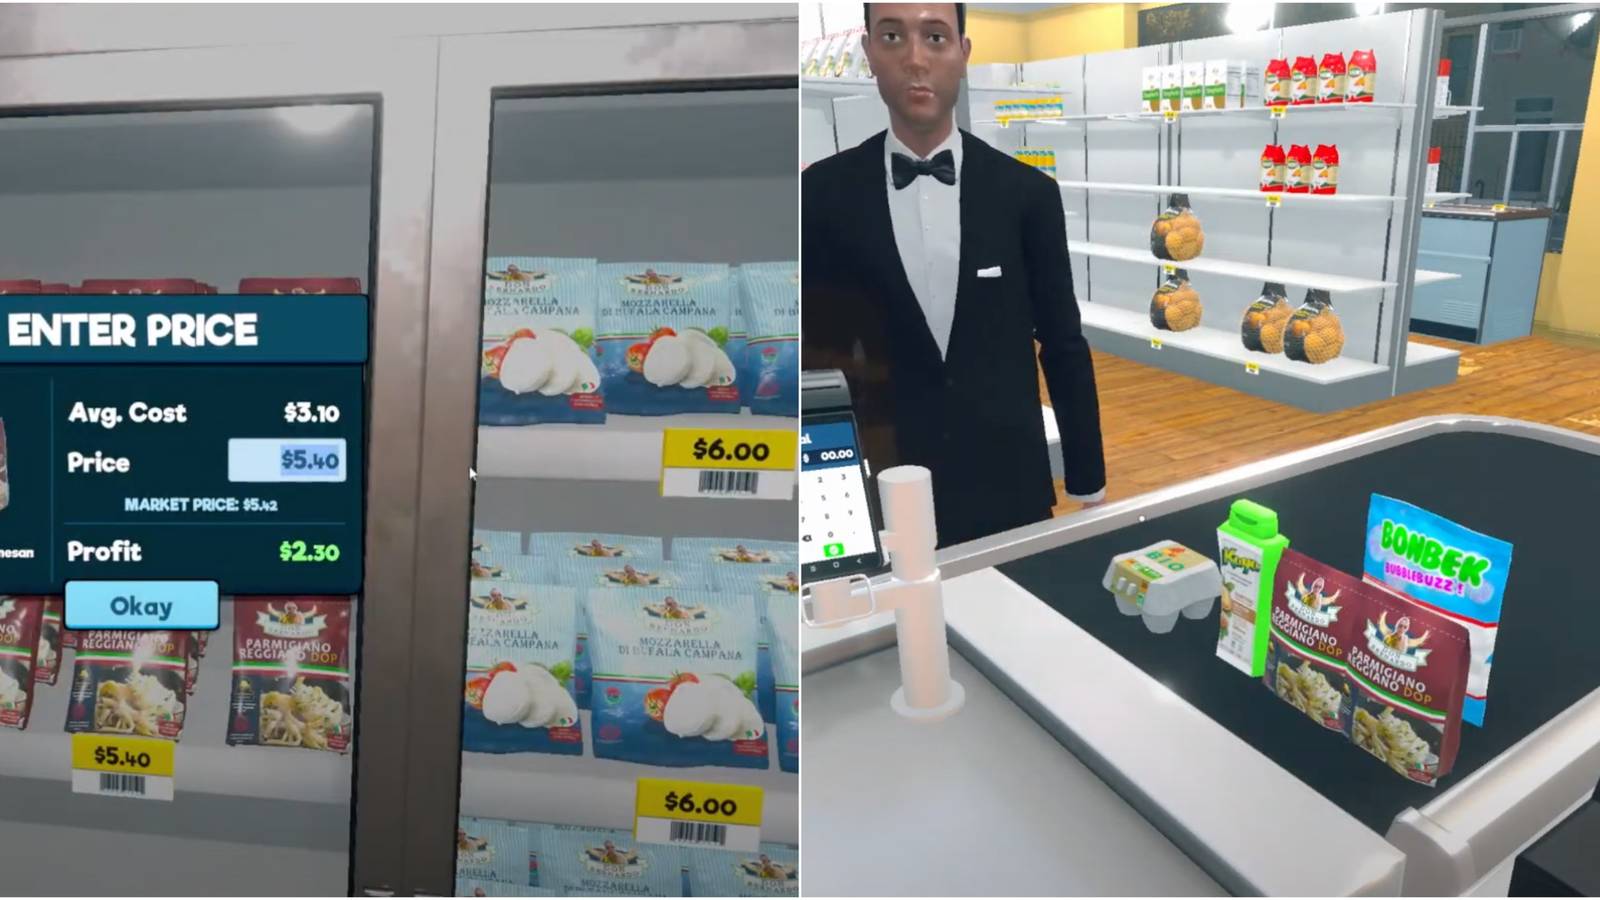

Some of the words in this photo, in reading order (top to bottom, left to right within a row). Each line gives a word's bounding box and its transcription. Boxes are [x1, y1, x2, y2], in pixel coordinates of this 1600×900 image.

[486, 296, 559, 307] OZZARELLA
[522, 305, 580, 317] CAMPANA
[621, 298, 697, 308] MOZZARELLA
[662, 306, 717, 318] CAMPANA
[8, 312, 137, 347] ENTER
[146, 312, 258, 347] PRICE
[67, 401, 123, 428] Avg.
[128, 401, 187, 423] Cost
[284, 401, 340, 423] $3.10
[280, 448, 339, 470] $5.40
[693, 437, 770, 462] $6.00
[820, 448, 854, 461] 00.00
[67, 451, 131, 473] Price
[124, 497, 190, 512] MARKET
[192, 497, 239, 512] PRICE:
[242, 497, 279, 512] $5.42
[67, 540, 142, 562] Profit
[279, 540, 340, 562] $2.30
[1380, 520, 1490, 588] BONBEK
[110, 595, 173, 621] Okay
[1275, 606, 1337, 647] PARMIGIANO
[82, 639, 142, 651] REGGIAN
[88, 630, 169, 644] PARMIGI
[245, 638, 332, 653] PARMIGIANO
[503, 638, 560, 650] CAMPANA
[639, 637, 721, 650] MOZZARELLA
[239, 648, 306, 661] REGGIAO
[310, 651, 338, 663] DOP
[617, 645, 630, 656] DI
[684, 647, 744, 661] CAMPANA
[1318, 640, 1343, 657] DOP
[1351, 645, 1426, 693] PARMIGIANO
[1403, 686, 1433, 705] DOP
[95, 746, 151, 768] $5.40
[664, 791, 737, 817] $6.00
